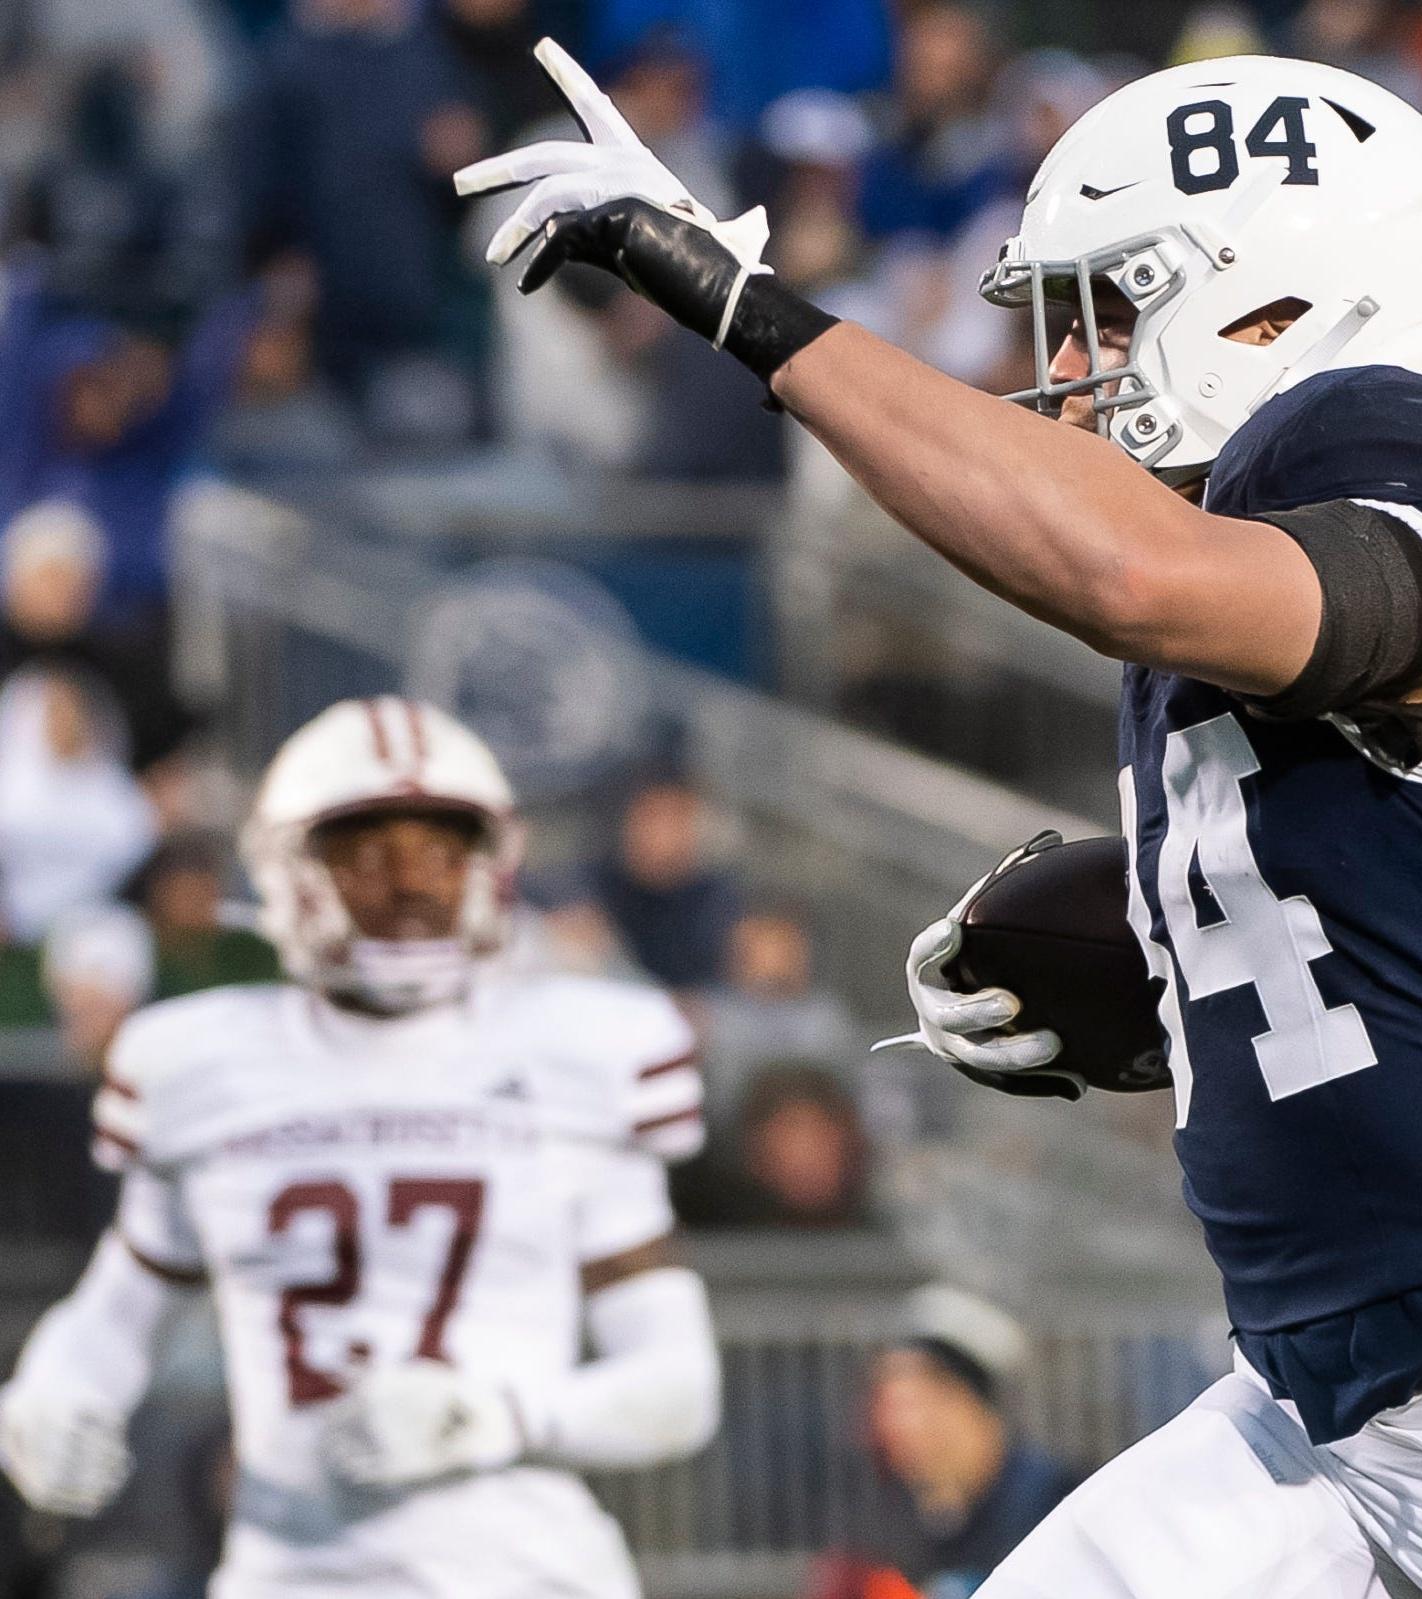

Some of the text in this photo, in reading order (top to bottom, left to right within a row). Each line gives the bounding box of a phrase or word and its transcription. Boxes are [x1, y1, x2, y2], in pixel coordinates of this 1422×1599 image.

[1166, 96, 1319, 196] 84
[1117, 711, 1378, 1129] 4
[269, 1178, 483, 1406] 27
